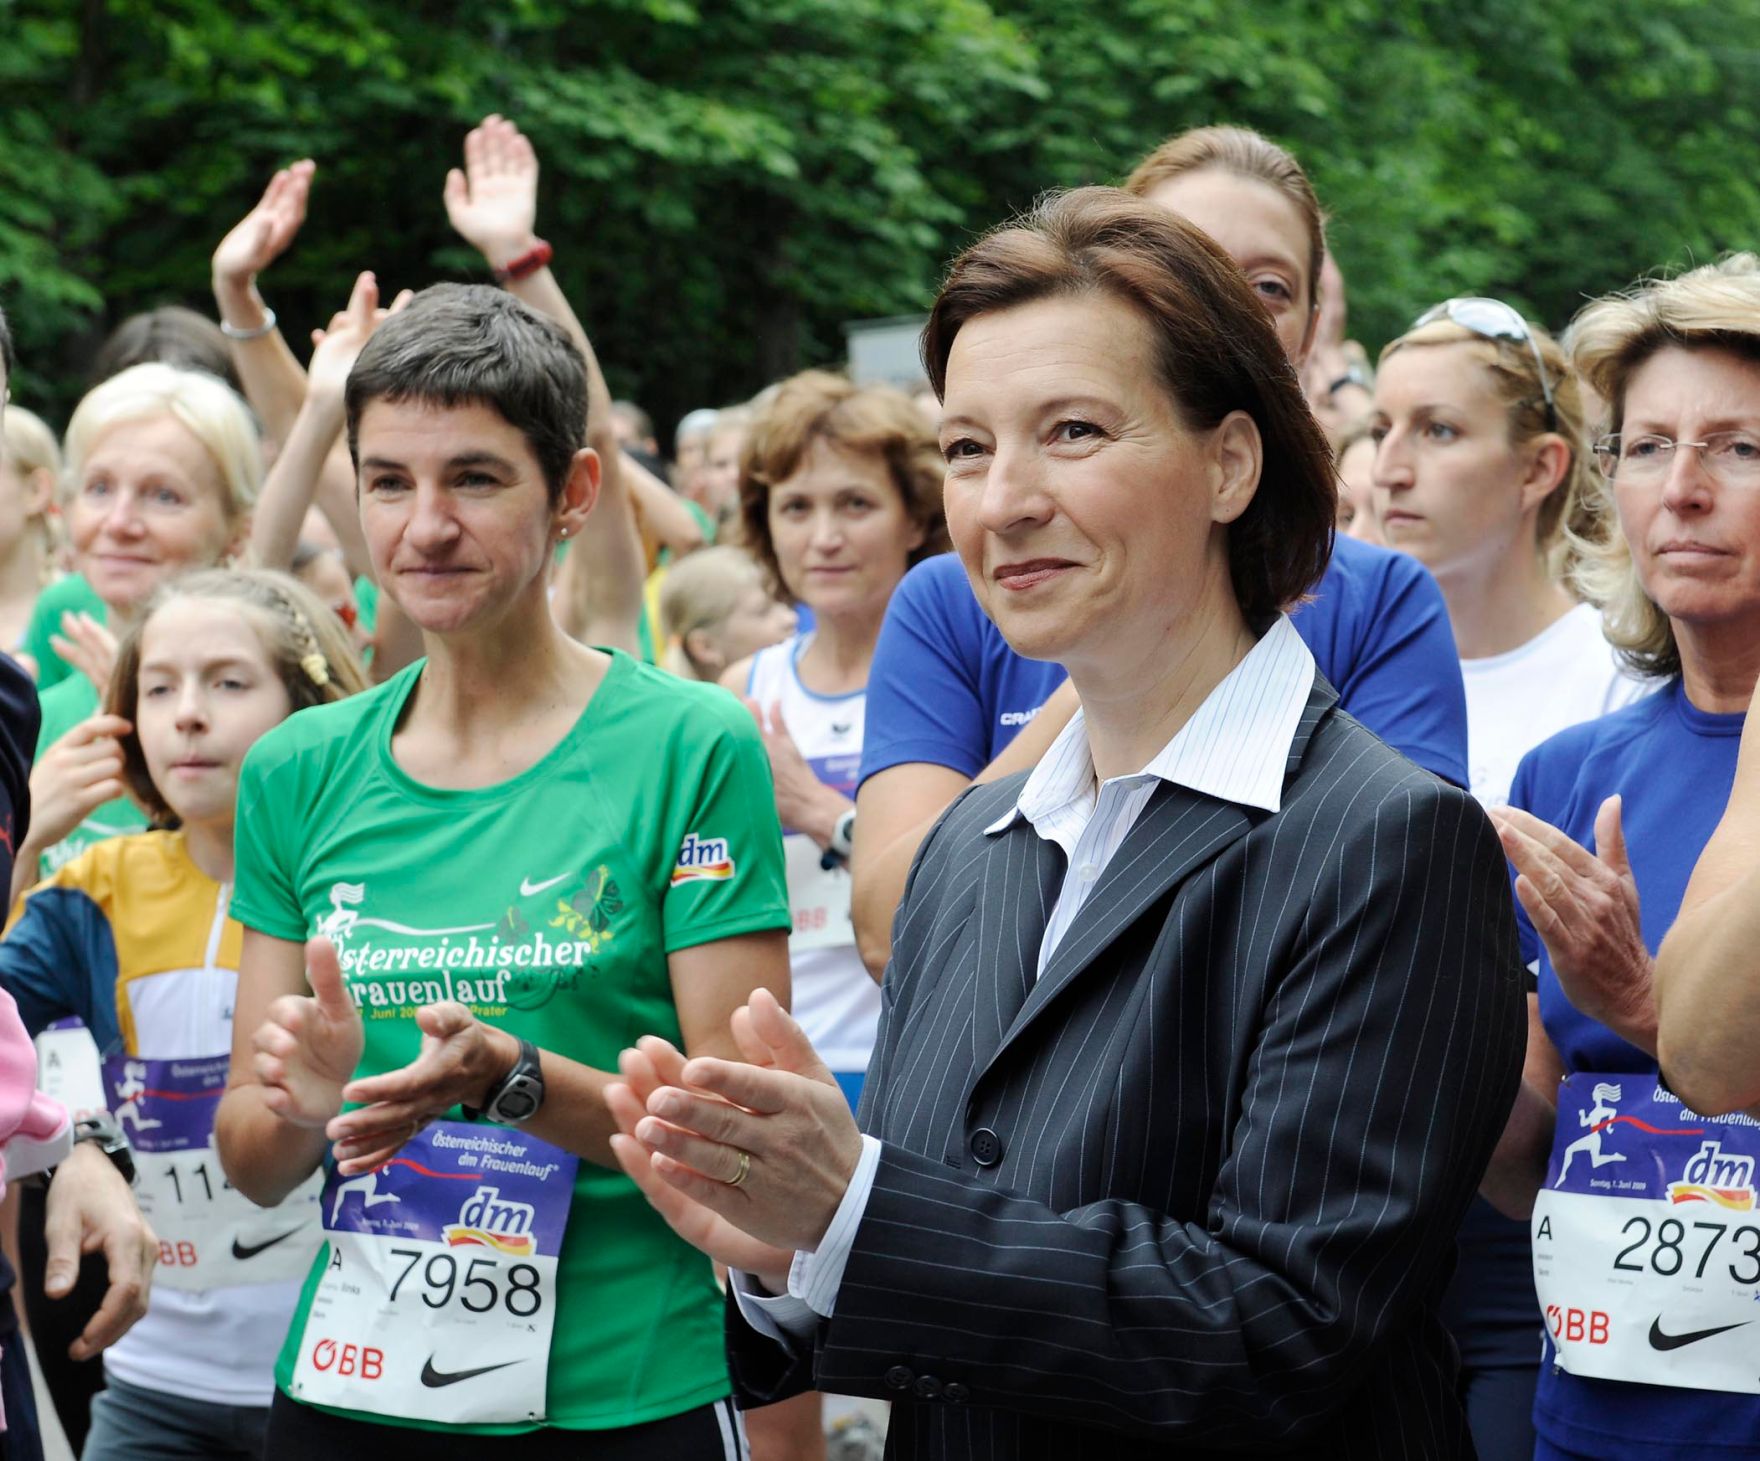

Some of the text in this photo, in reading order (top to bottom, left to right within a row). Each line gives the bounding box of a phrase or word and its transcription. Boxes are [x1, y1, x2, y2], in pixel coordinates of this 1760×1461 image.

[678, 837, 723, 866] dm
[344, 968, 512, 1007] rauenlauf
[371, 1006, 396, 1020] Juni
[471, 1003, 509, 1017] Prater
[432, 1129, 528, 1158] Österreichischer
[457, 1151, 479, 1168] dm
[164, 1162, 234, 1202] 11
[1690, 1145, 1748, 1187] dm
[463, 1189, 529, 1234] dm
[159, 1240, 197, 1267] BB
[1537, 1215, 1760, 1285] A 2873
[329, 1246, 542, 1317] A 7958
[312, 1338, 384, 1380] ÖBB
